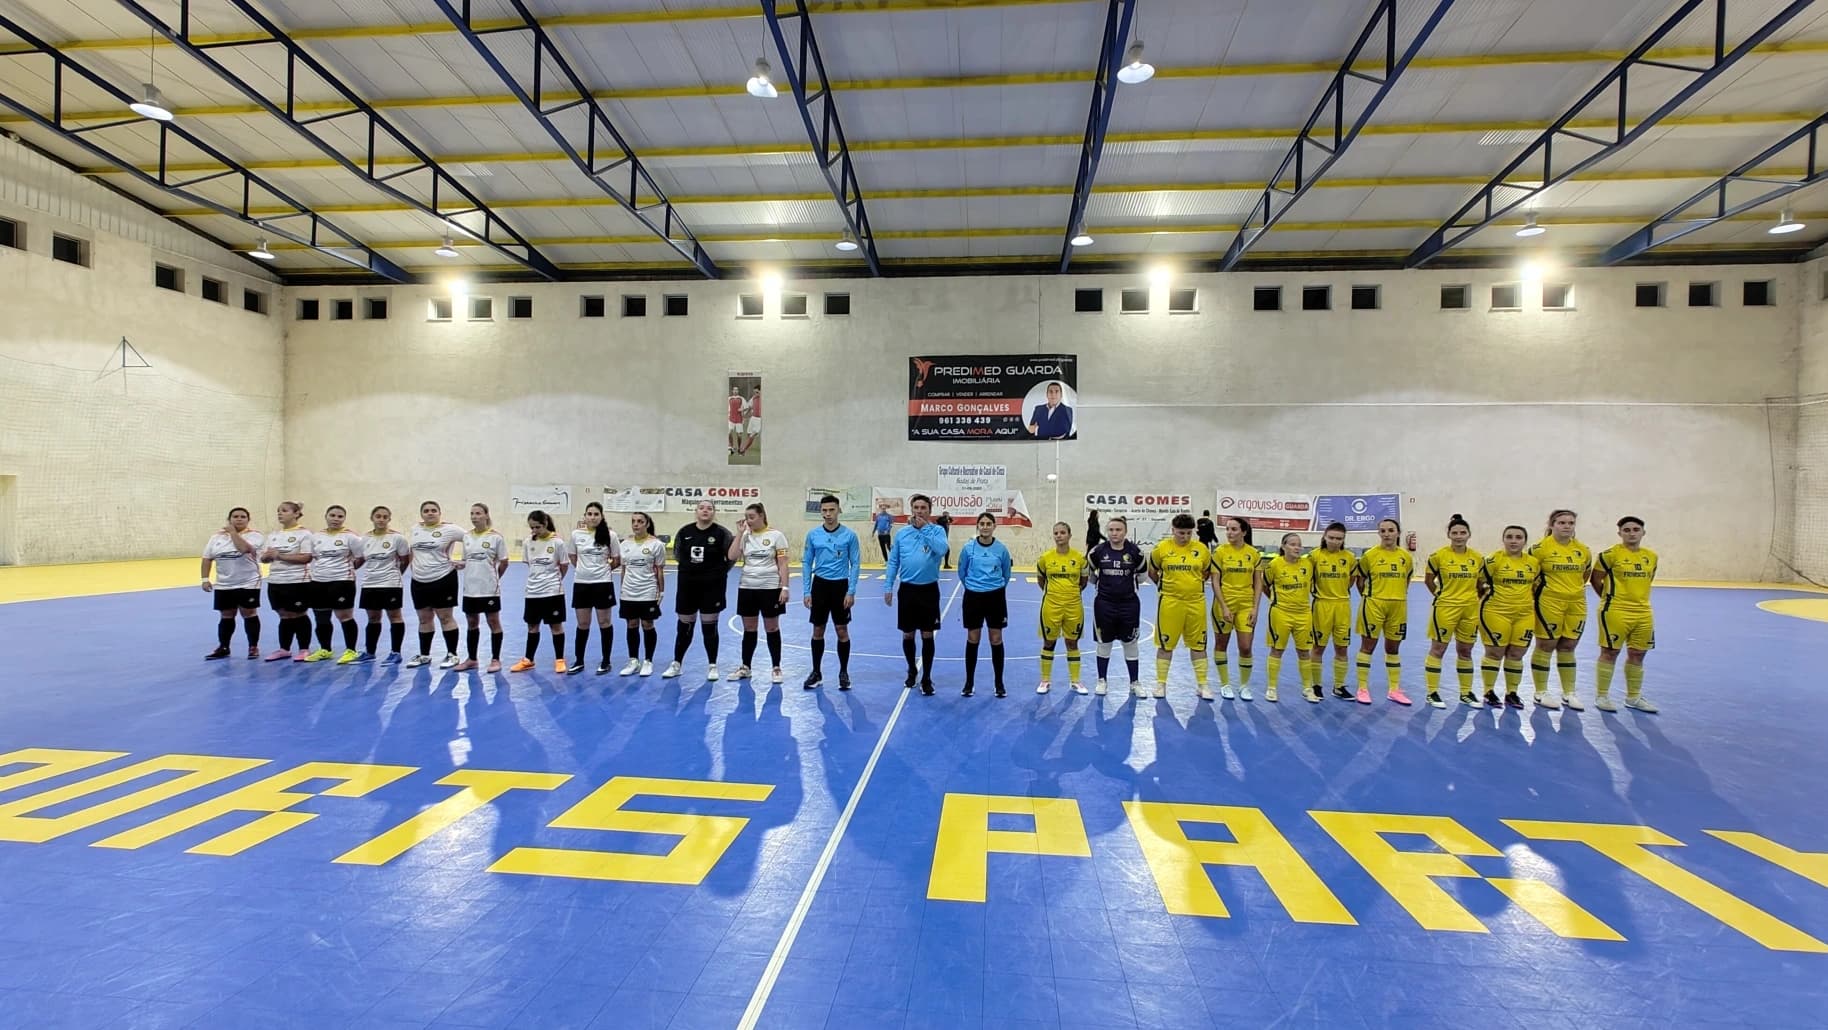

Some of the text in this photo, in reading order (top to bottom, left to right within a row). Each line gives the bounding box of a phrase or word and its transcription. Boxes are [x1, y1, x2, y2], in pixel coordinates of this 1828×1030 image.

[934, 365, 1064, 376] PREDIMED GUARDA
[952, 377, 1001, 385] IMOBILIÁRIA
[920, 403, 1010, 415] MARCO GONÇALVES
[938, 416, 991, 424] 961 338 439
[665, 487, 759, 498] CASA GOMES
[931, 494, 983, 510] ergovisão
[1086, 495, 1190, 505] CASA GOMES
[1237, 498, 1284, 512] ergovisão
[1113, 560, 1121, 568] 12
